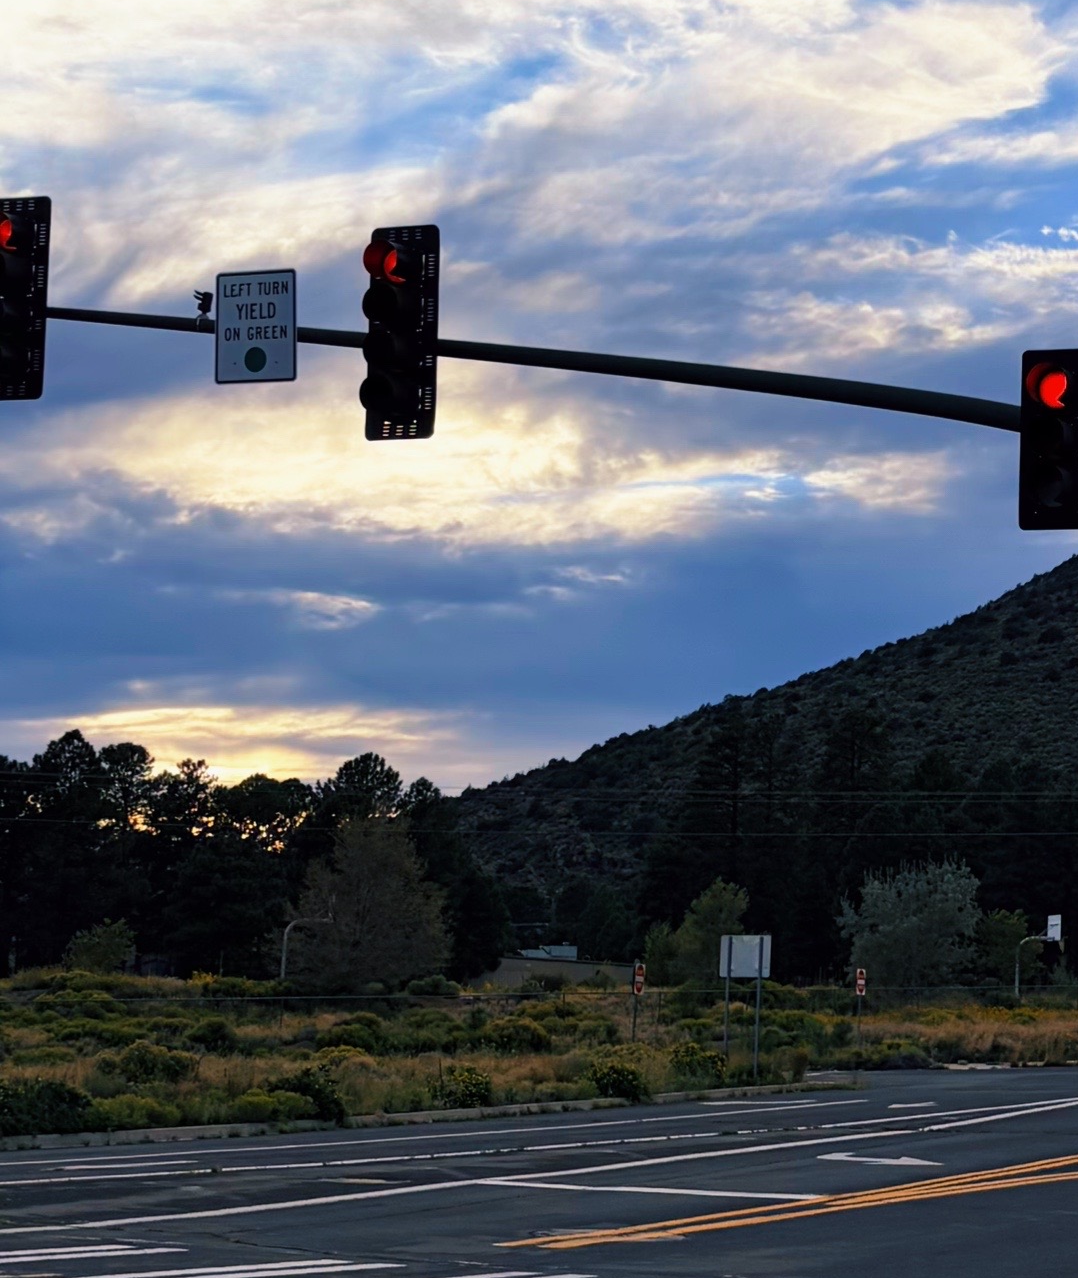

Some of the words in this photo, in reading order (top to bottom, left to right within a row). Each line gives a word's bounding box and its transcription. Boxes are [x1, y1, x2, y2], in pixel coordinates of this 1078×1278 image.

[224, 283, 251, 298] LEFT
[257, 281, 288, 295] TURN
[236, 302, 276, 320] YIELD
[224, 327, 240, 341] ON
[247, 325, 287, 340] GREEN
